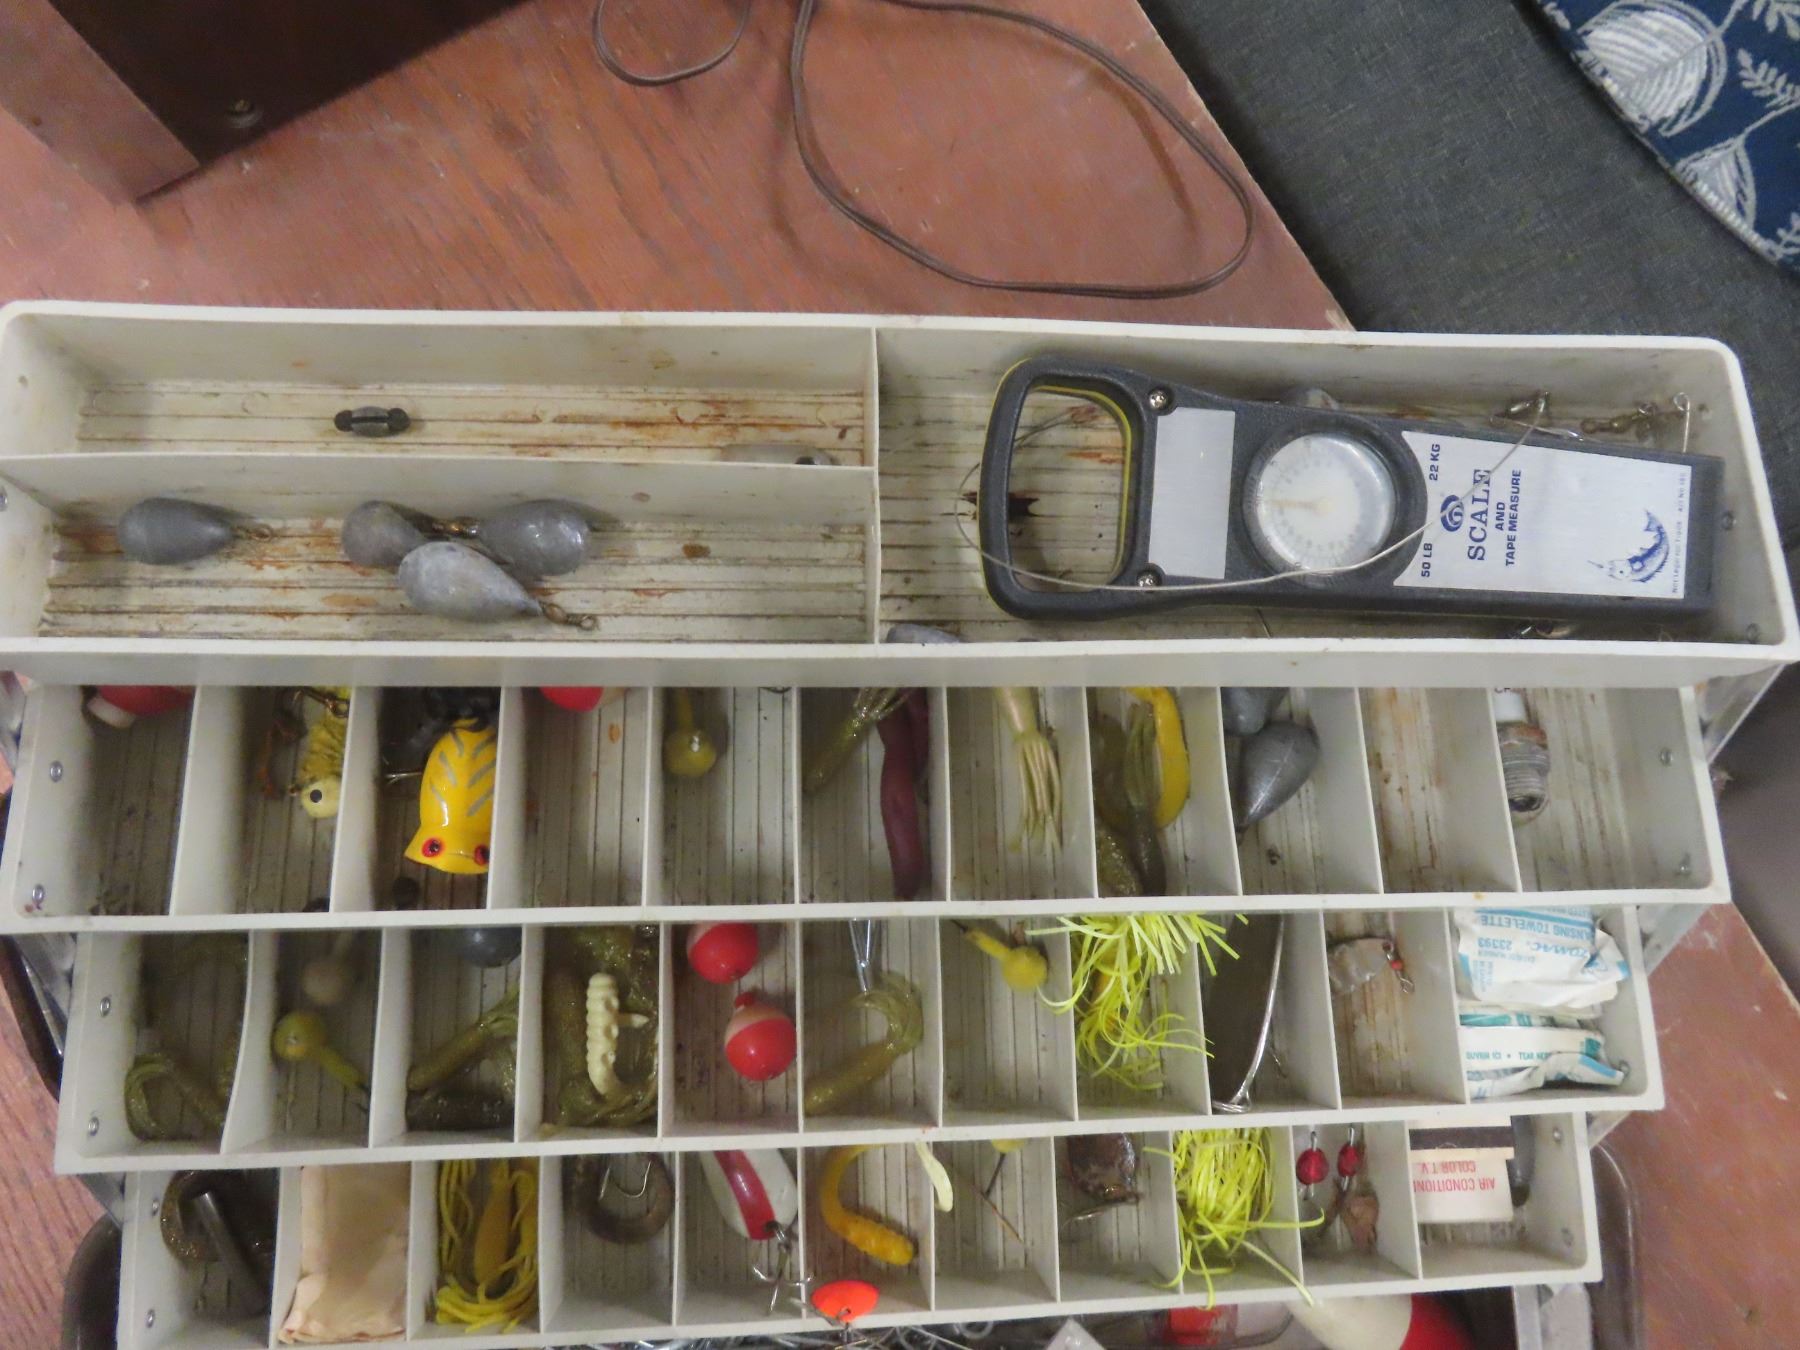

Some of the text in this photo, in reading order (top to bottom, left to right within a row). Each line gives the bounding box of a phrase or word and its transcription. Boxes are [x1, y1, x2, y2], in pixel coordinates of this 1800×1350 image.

[1429, 443, 1441, 481] 22 KG
[1467, 469, 1491, 561] SCALE
[1495, 501, 1505, 531] AND
[1505, 469, 1521, 567] TAPE MEASURE
[1421, 542, 1433, 577] 50 LB
[1480, 915, 1550, 934] TOWELETTE
[1441, 1160, 1476, 1174] COLOR
[1480, 1176, 1496, 1190] AIR
